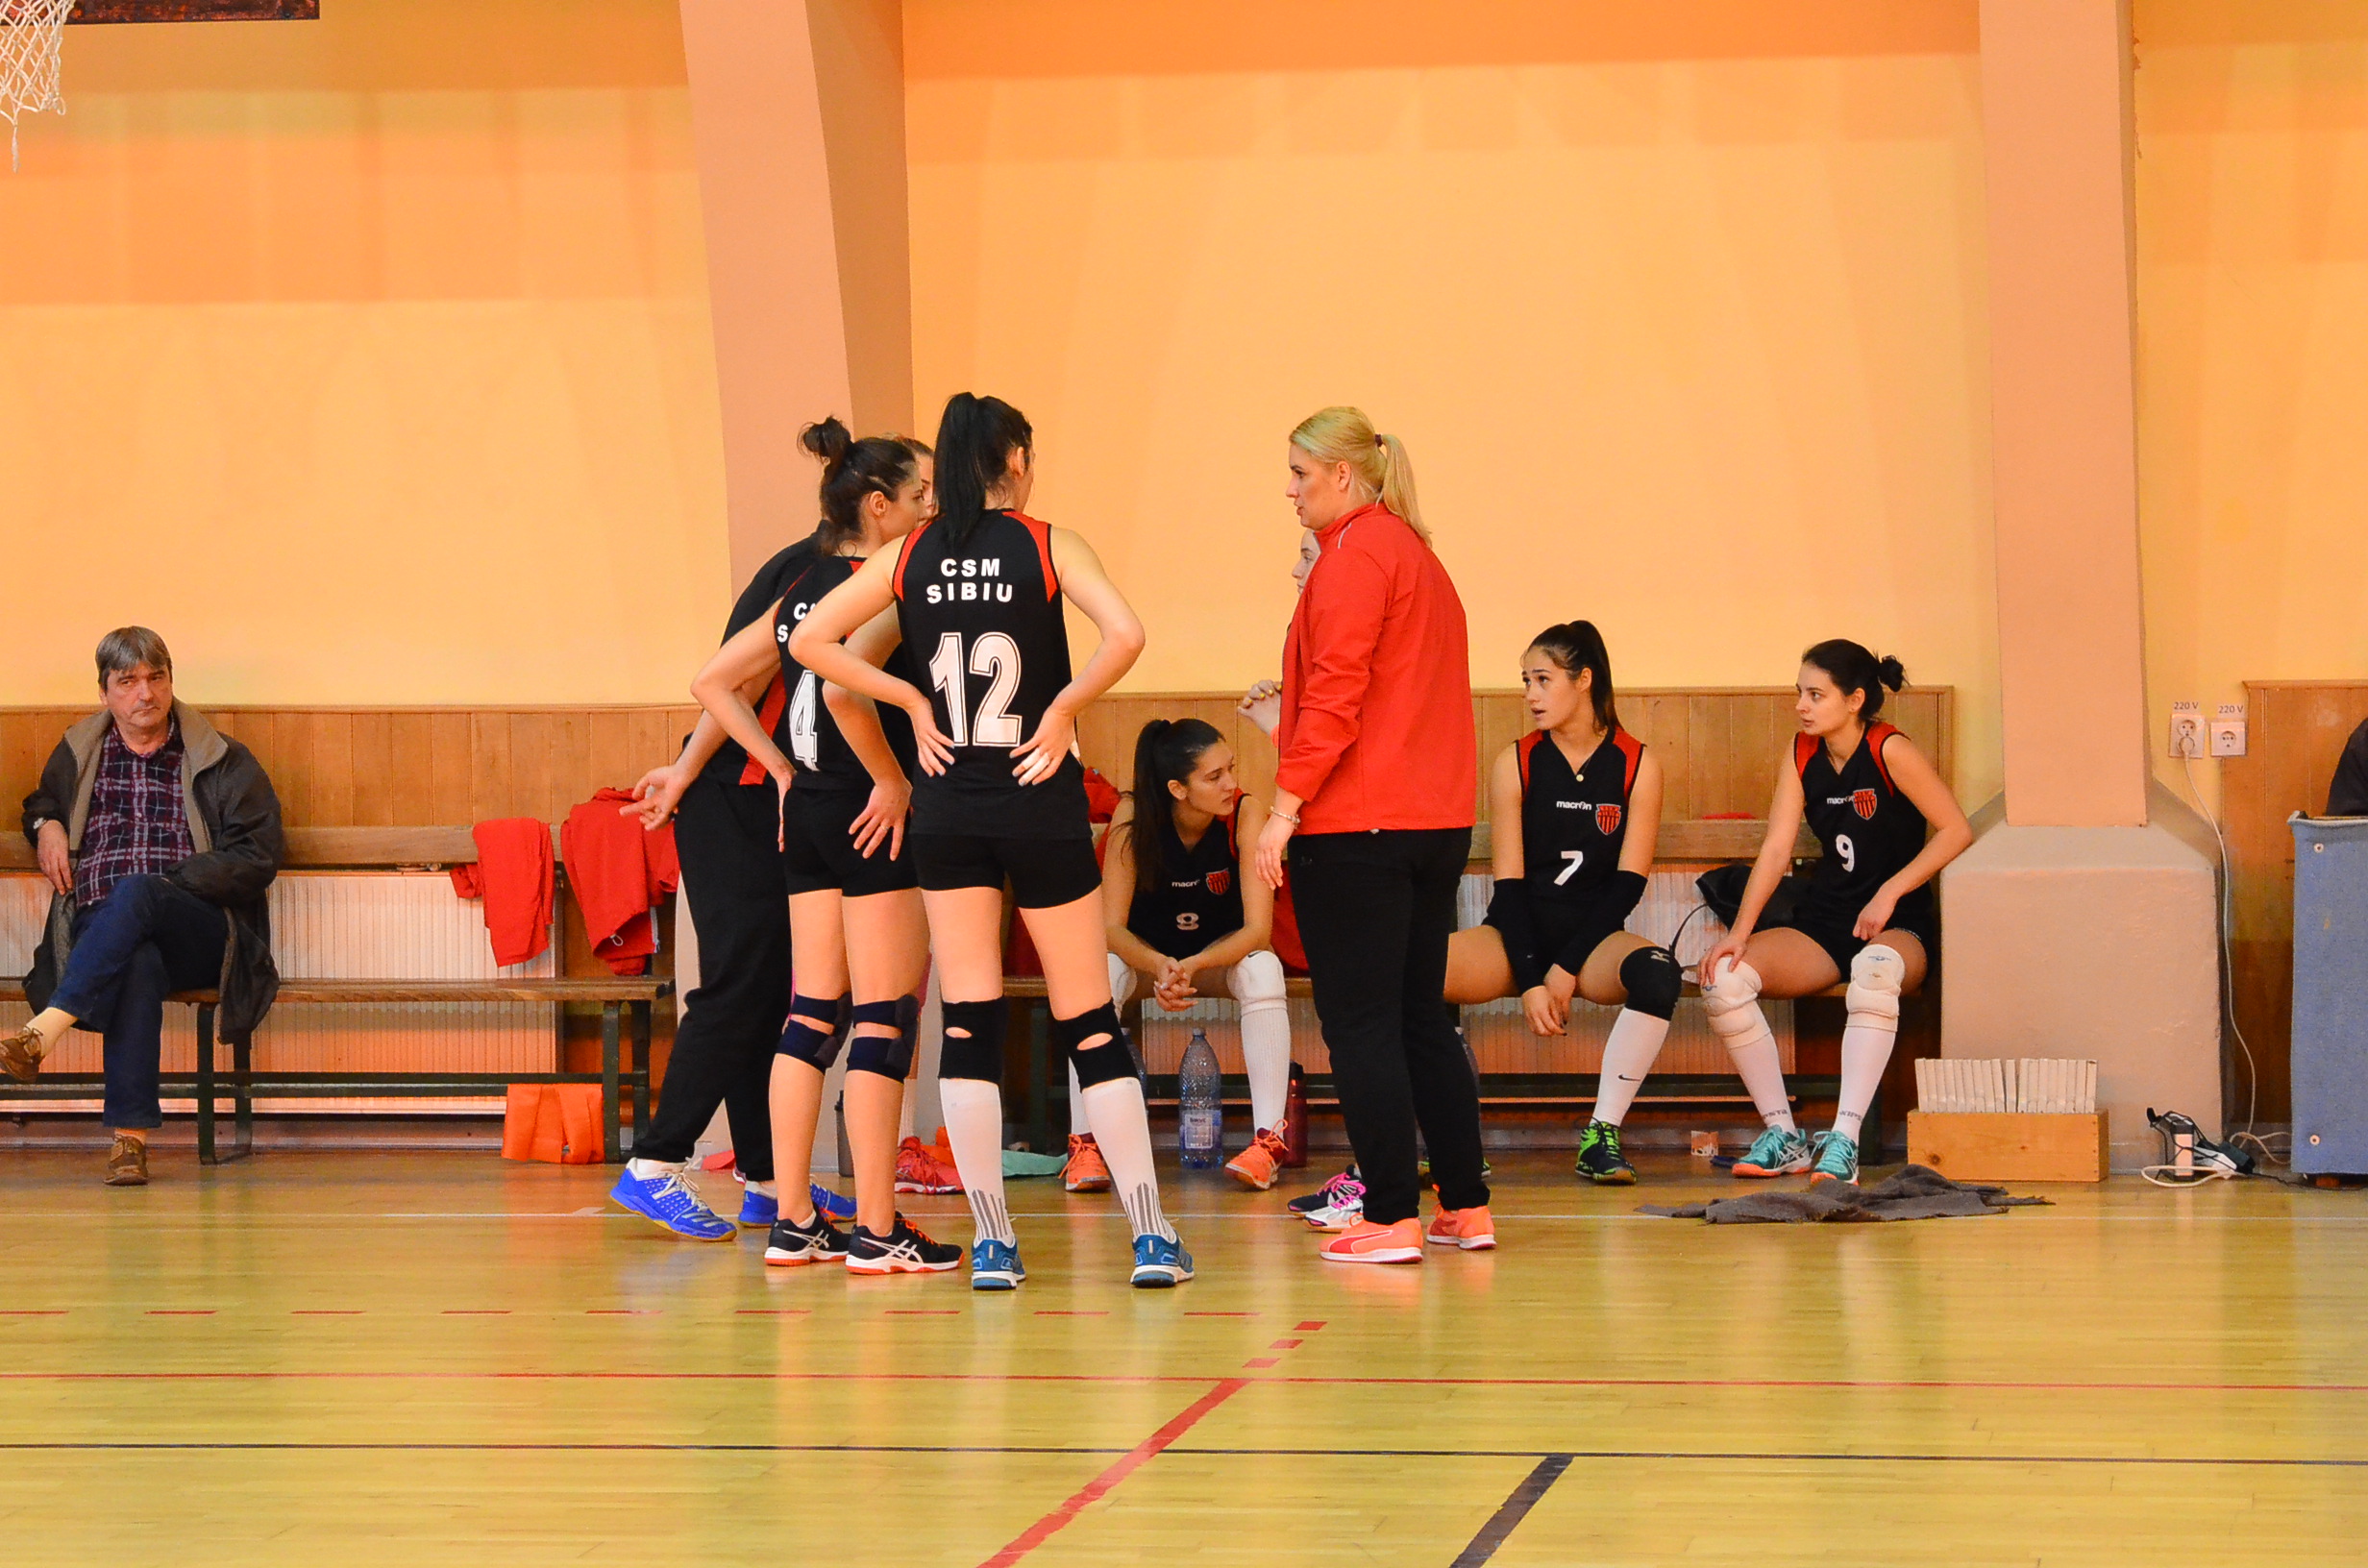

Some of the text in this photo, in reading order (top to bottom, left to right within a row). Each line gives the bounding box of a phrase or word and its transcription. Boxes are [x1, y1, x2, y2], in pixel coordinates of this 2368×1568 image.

[941, 558, 999, 576] CSM
[926, 582, 1012, 603] SIBIU
[929, 631, 1023, 747] 12
[2174, 701, 2190, 710] 220
[789, 670, 821, 772] 4
[1556, 800, 1591, 810] macron
[1836, 834, 1855, 872] 9
[1554, 850, 1583, 886] 7
